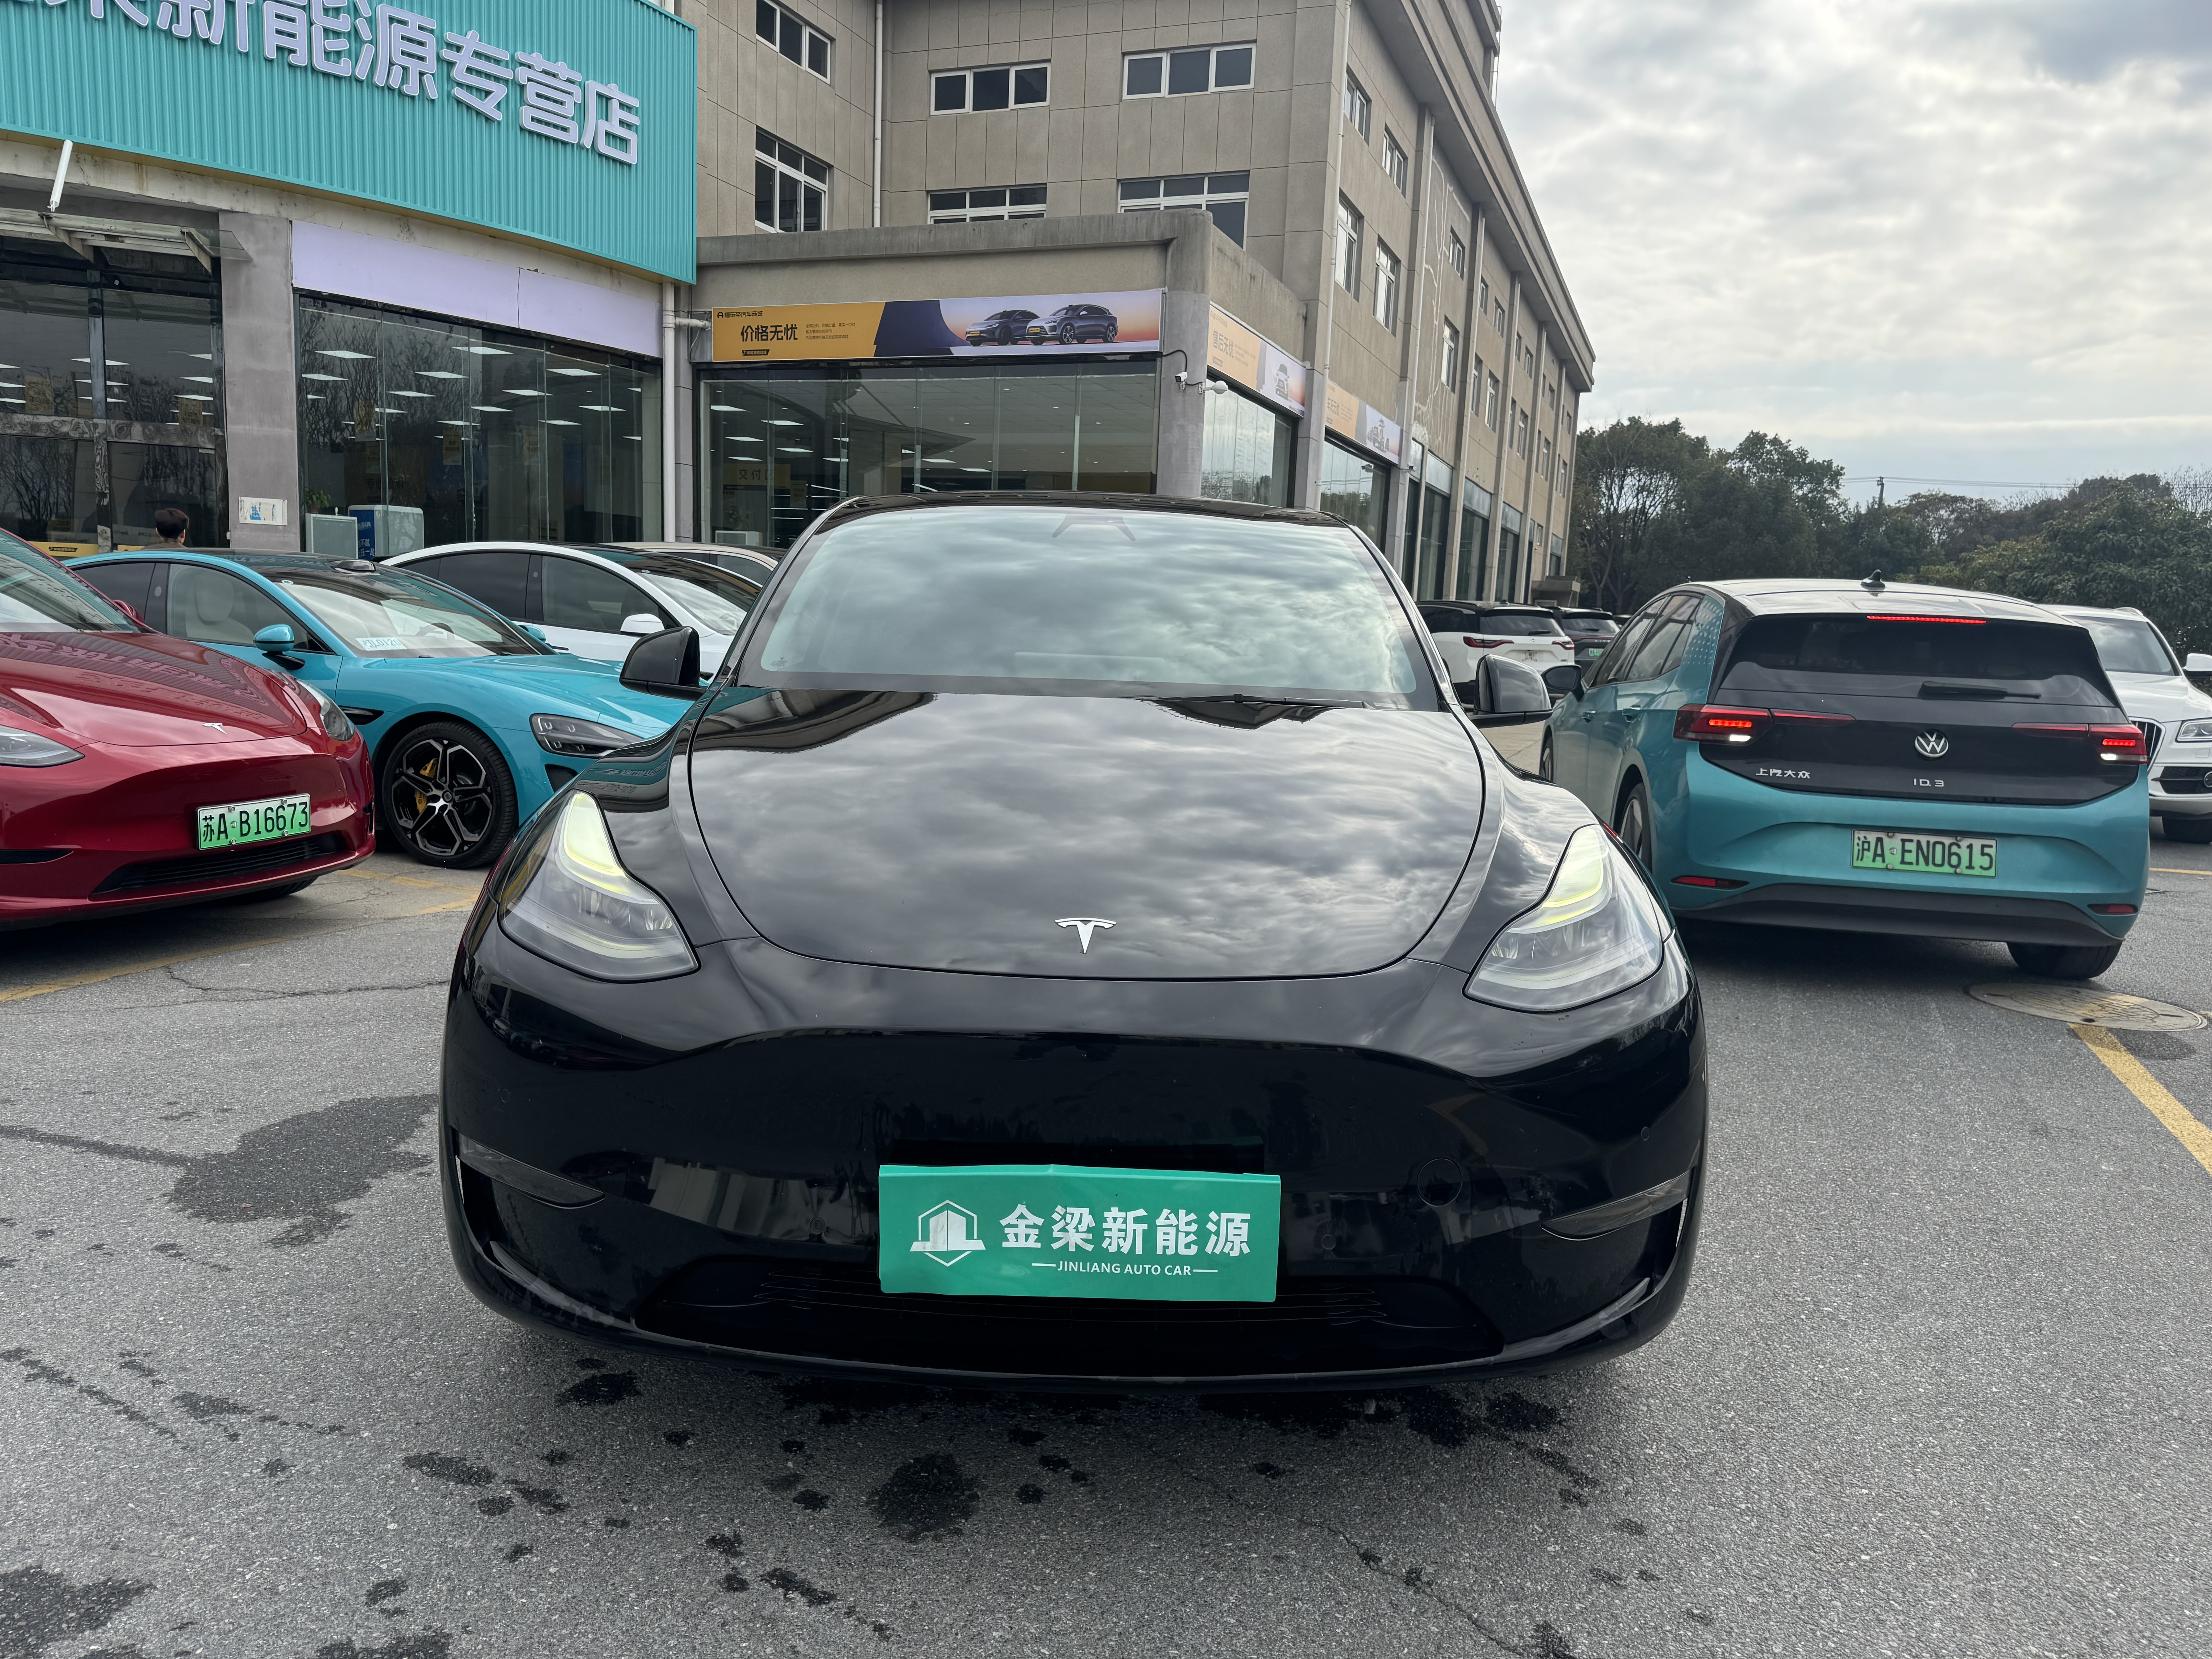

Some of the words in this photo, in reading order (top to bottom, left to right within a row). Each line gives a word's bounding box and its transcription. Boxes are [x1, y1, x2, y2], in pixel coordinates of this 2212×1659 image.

[46, 0, 640, 165] 新能源专营店
[740, 324, 798, 342] 价格无忧
[1756, 768, 1810, 779] 上汽大众
[1914, 778, 1944, 787] ID.3
[1000, 1204, 1251, 1257] 金梁新能源
[1057, 1261, 1120, 1274] JINLIANG
[1124, 1264, 1161, 1275] AUTO
[1164, 1265, 1192, 1276] CAR
